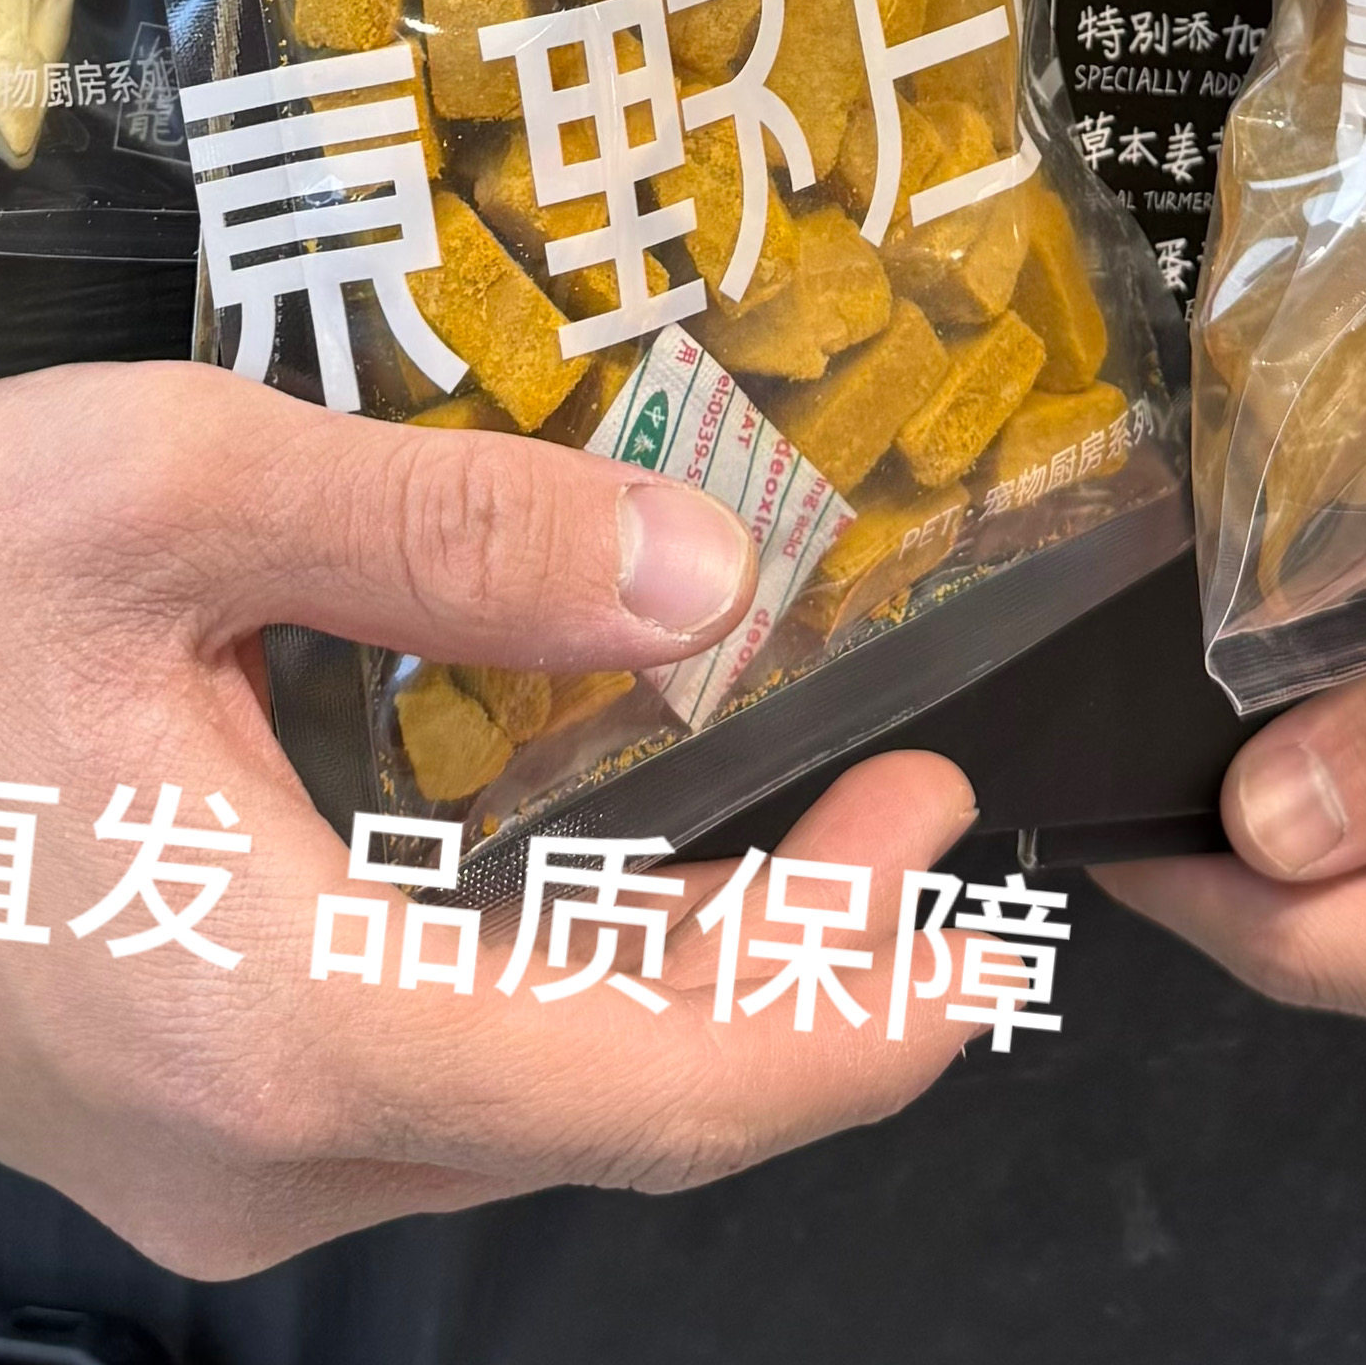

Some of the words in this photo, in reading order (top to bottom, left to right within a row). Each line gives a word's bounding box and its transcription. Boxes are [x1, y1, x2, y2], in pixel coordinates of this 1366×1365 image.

[1073, 64, 1192, 97] SPECIALLY
[900, 502, 954, 557] PET
[978, 392, 1156, 523] 宠物厨房系列
